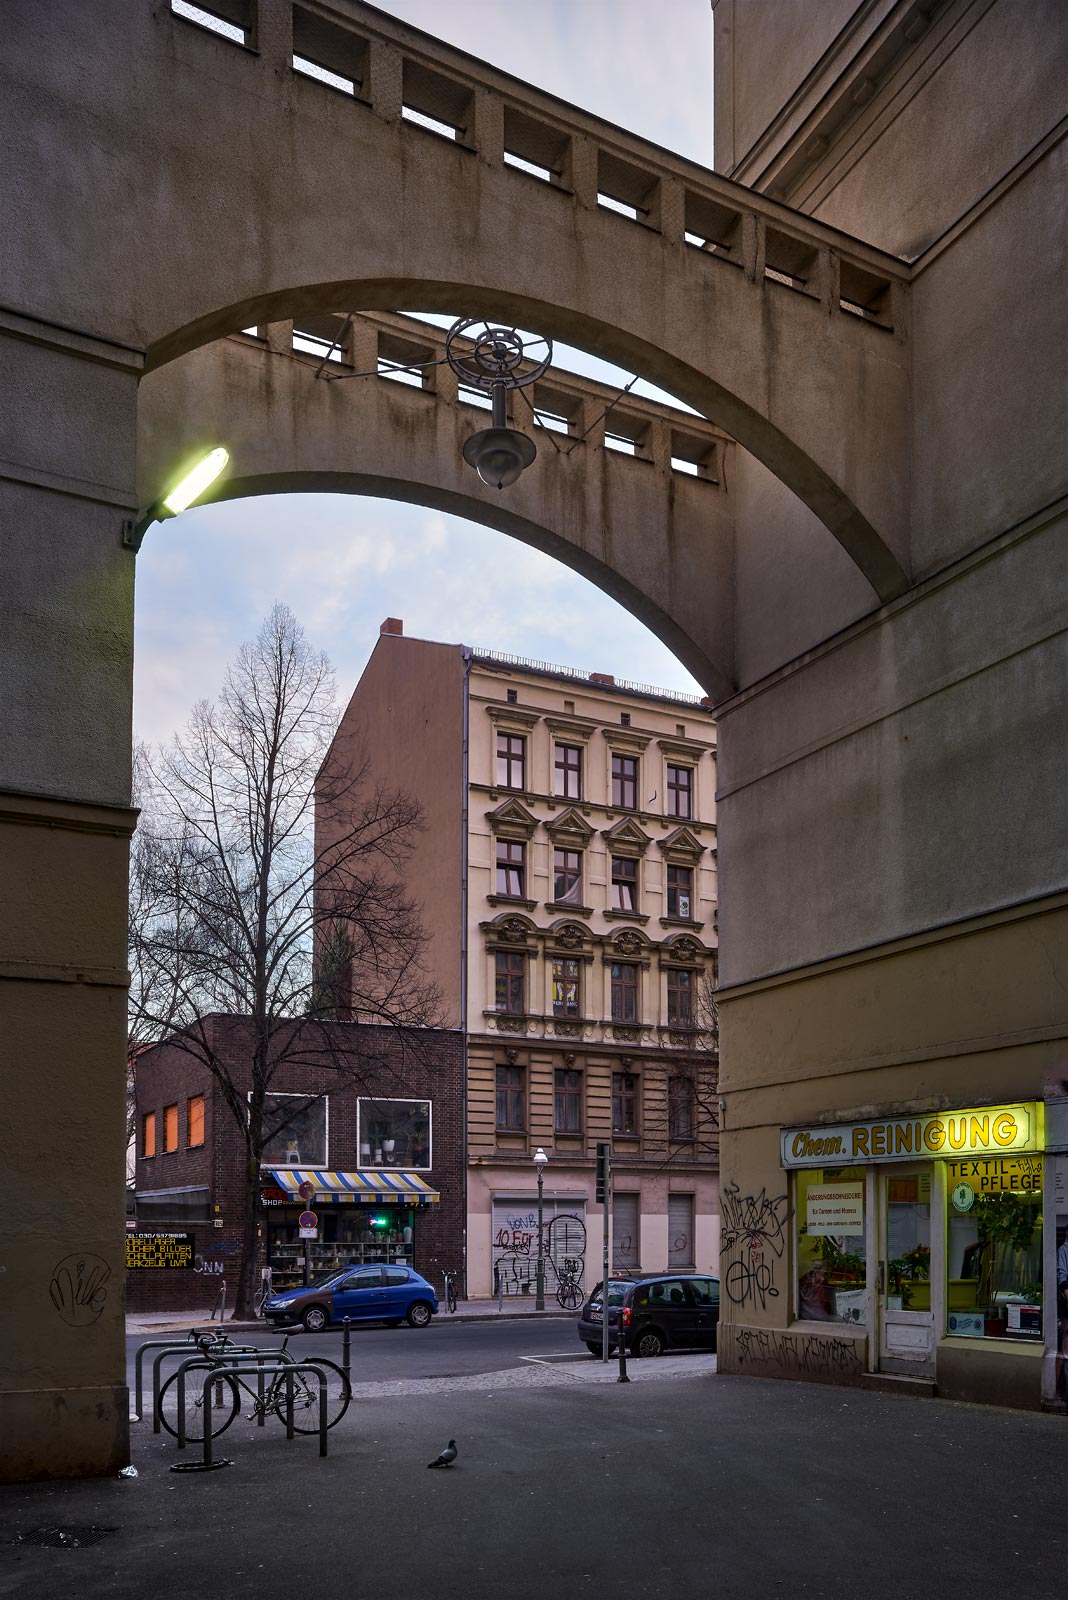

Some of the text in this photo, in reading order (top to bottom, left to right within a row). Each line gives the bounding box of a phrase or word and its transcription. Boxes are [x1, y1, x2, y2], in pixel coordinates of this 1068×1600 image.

[792, 1113, 1017, 1158] Chem. REINIGUNG
[949, 1160, 1016, 1177] TEXTIL-
[980, 1174, 1041, 1190] PFLEGE
